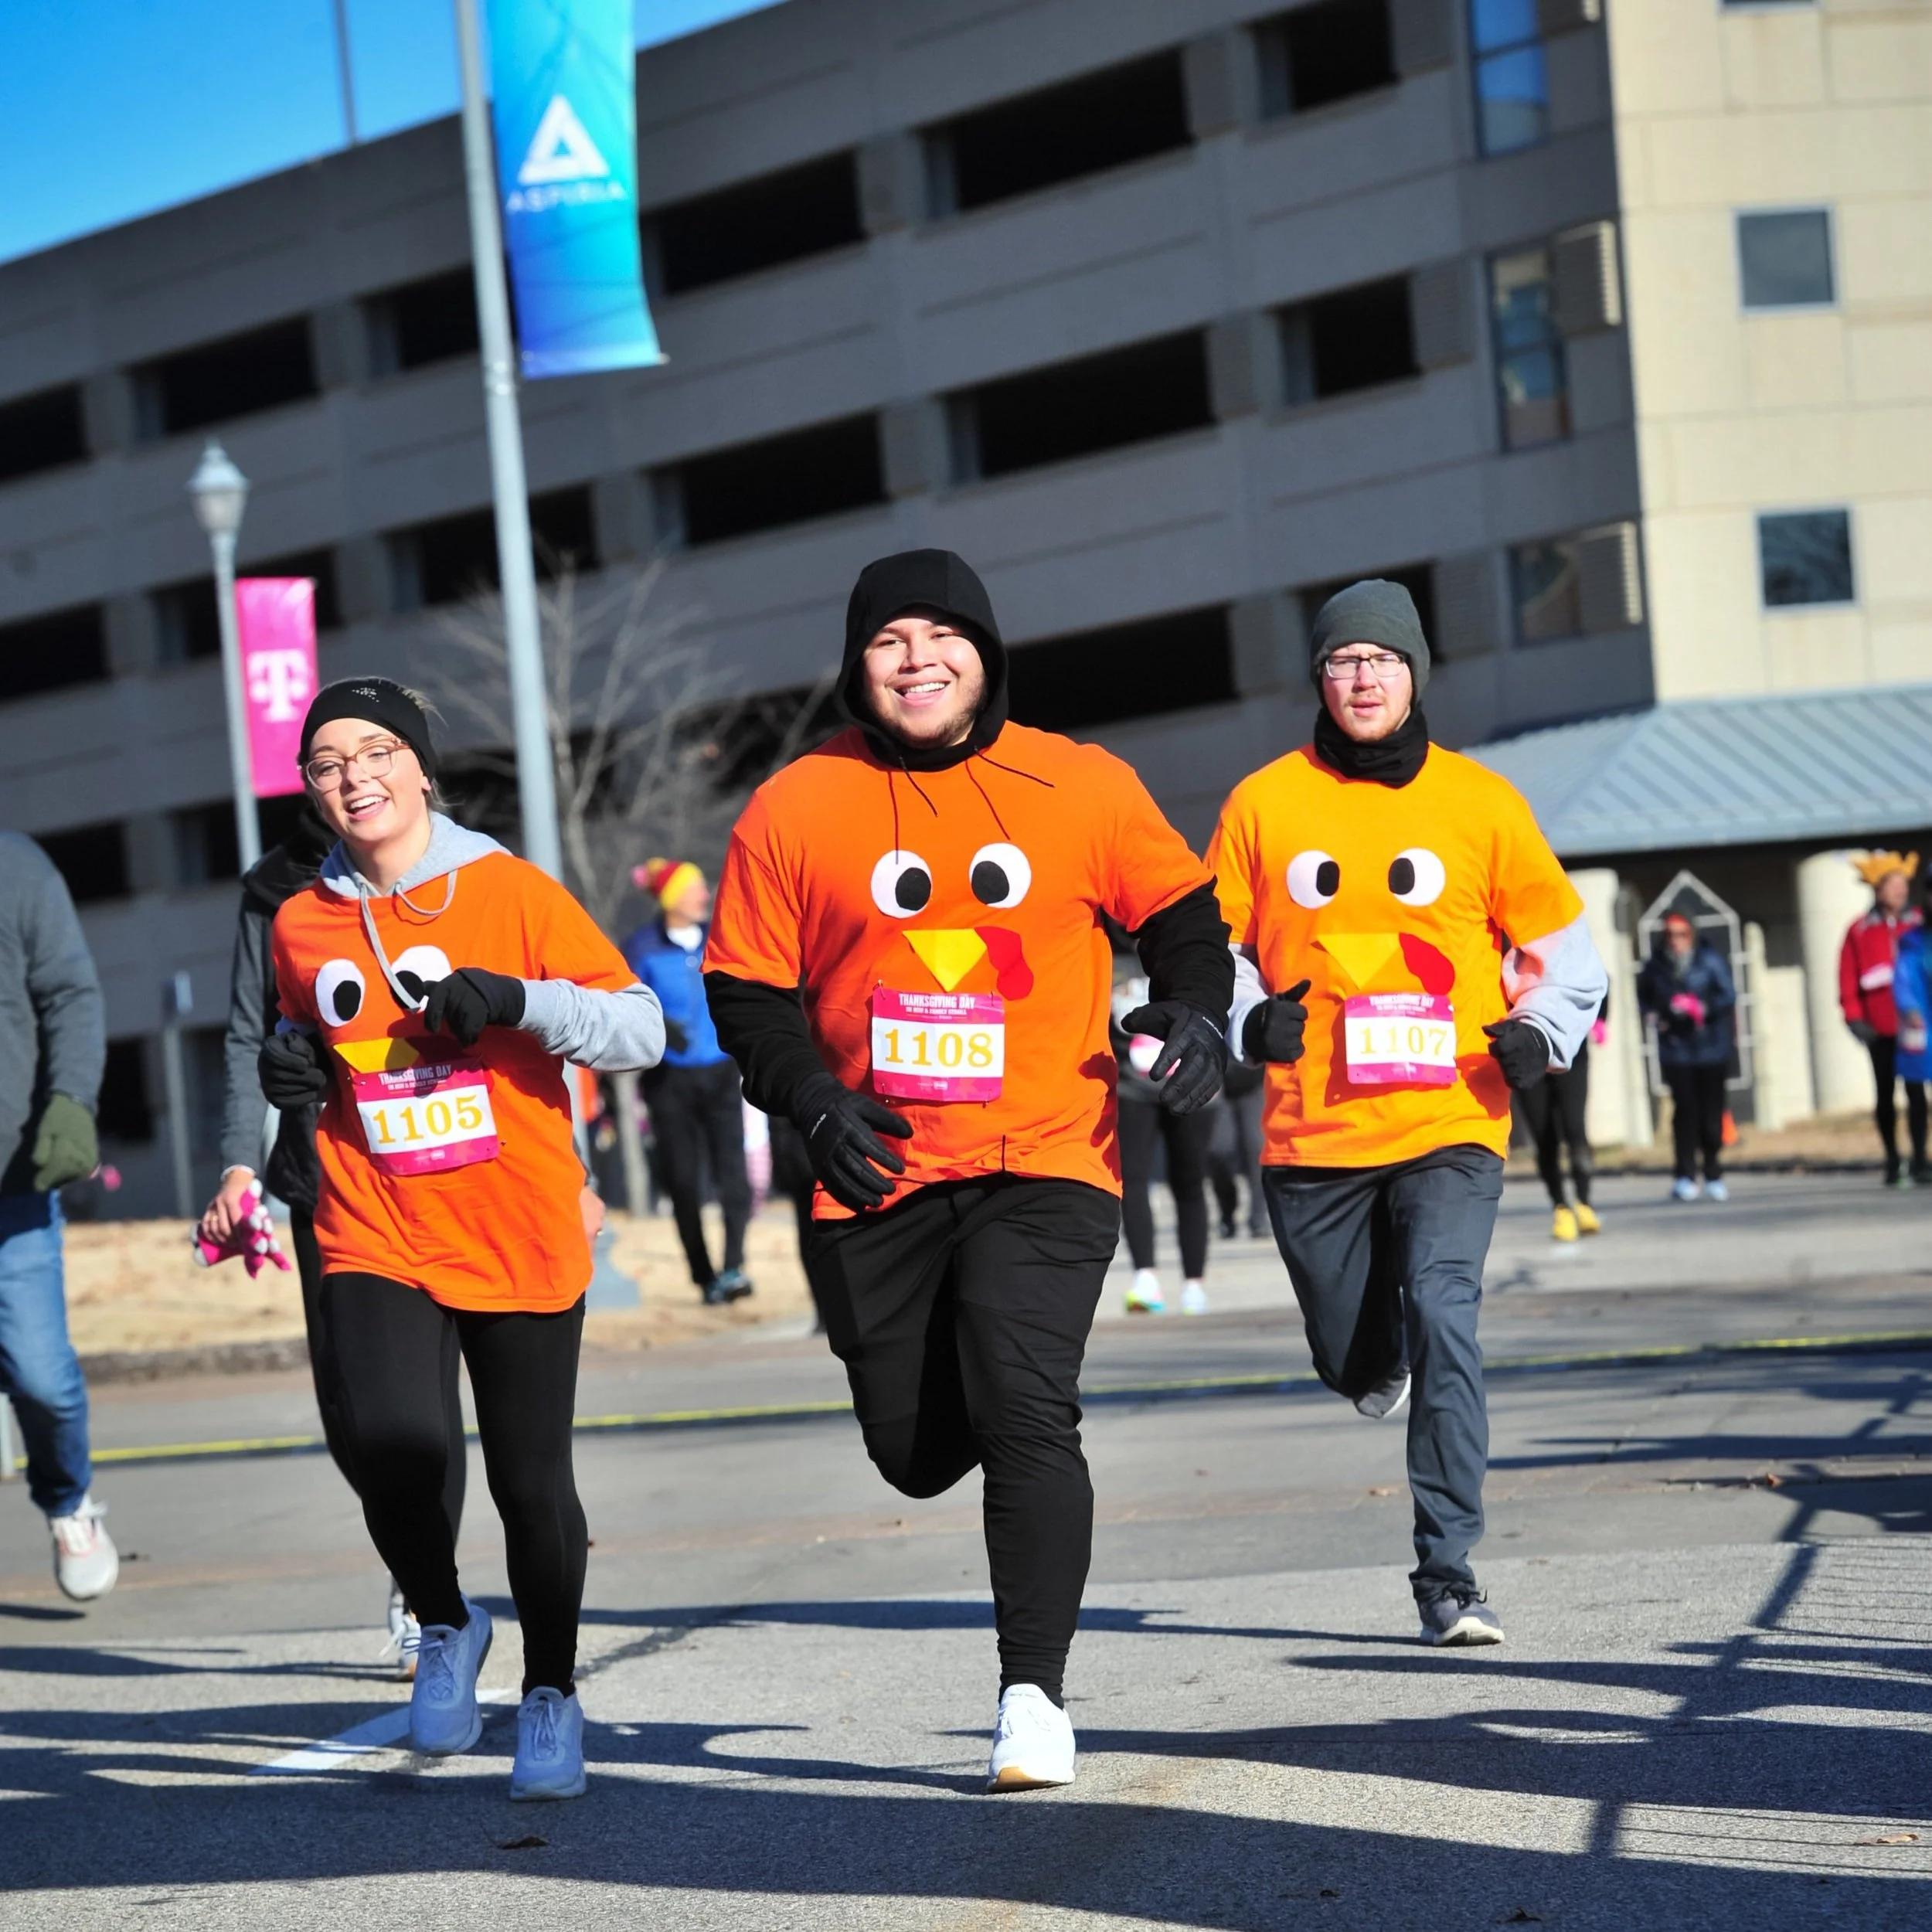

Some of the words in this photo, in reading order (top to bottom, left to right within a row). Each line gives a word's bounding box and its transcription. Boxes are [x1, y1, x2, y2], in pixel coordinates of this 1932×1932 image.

[899, 993, 957, 1008] THANKSGIVING
[958, 995, 975, 1009] DAY
[885, 1028, 993, 1068] 1108
[1360, 1026, 1447, 1056] 1107
[435, 1064, 451, 1077] DAY
[373, 1094, 482, 1145] 1105
